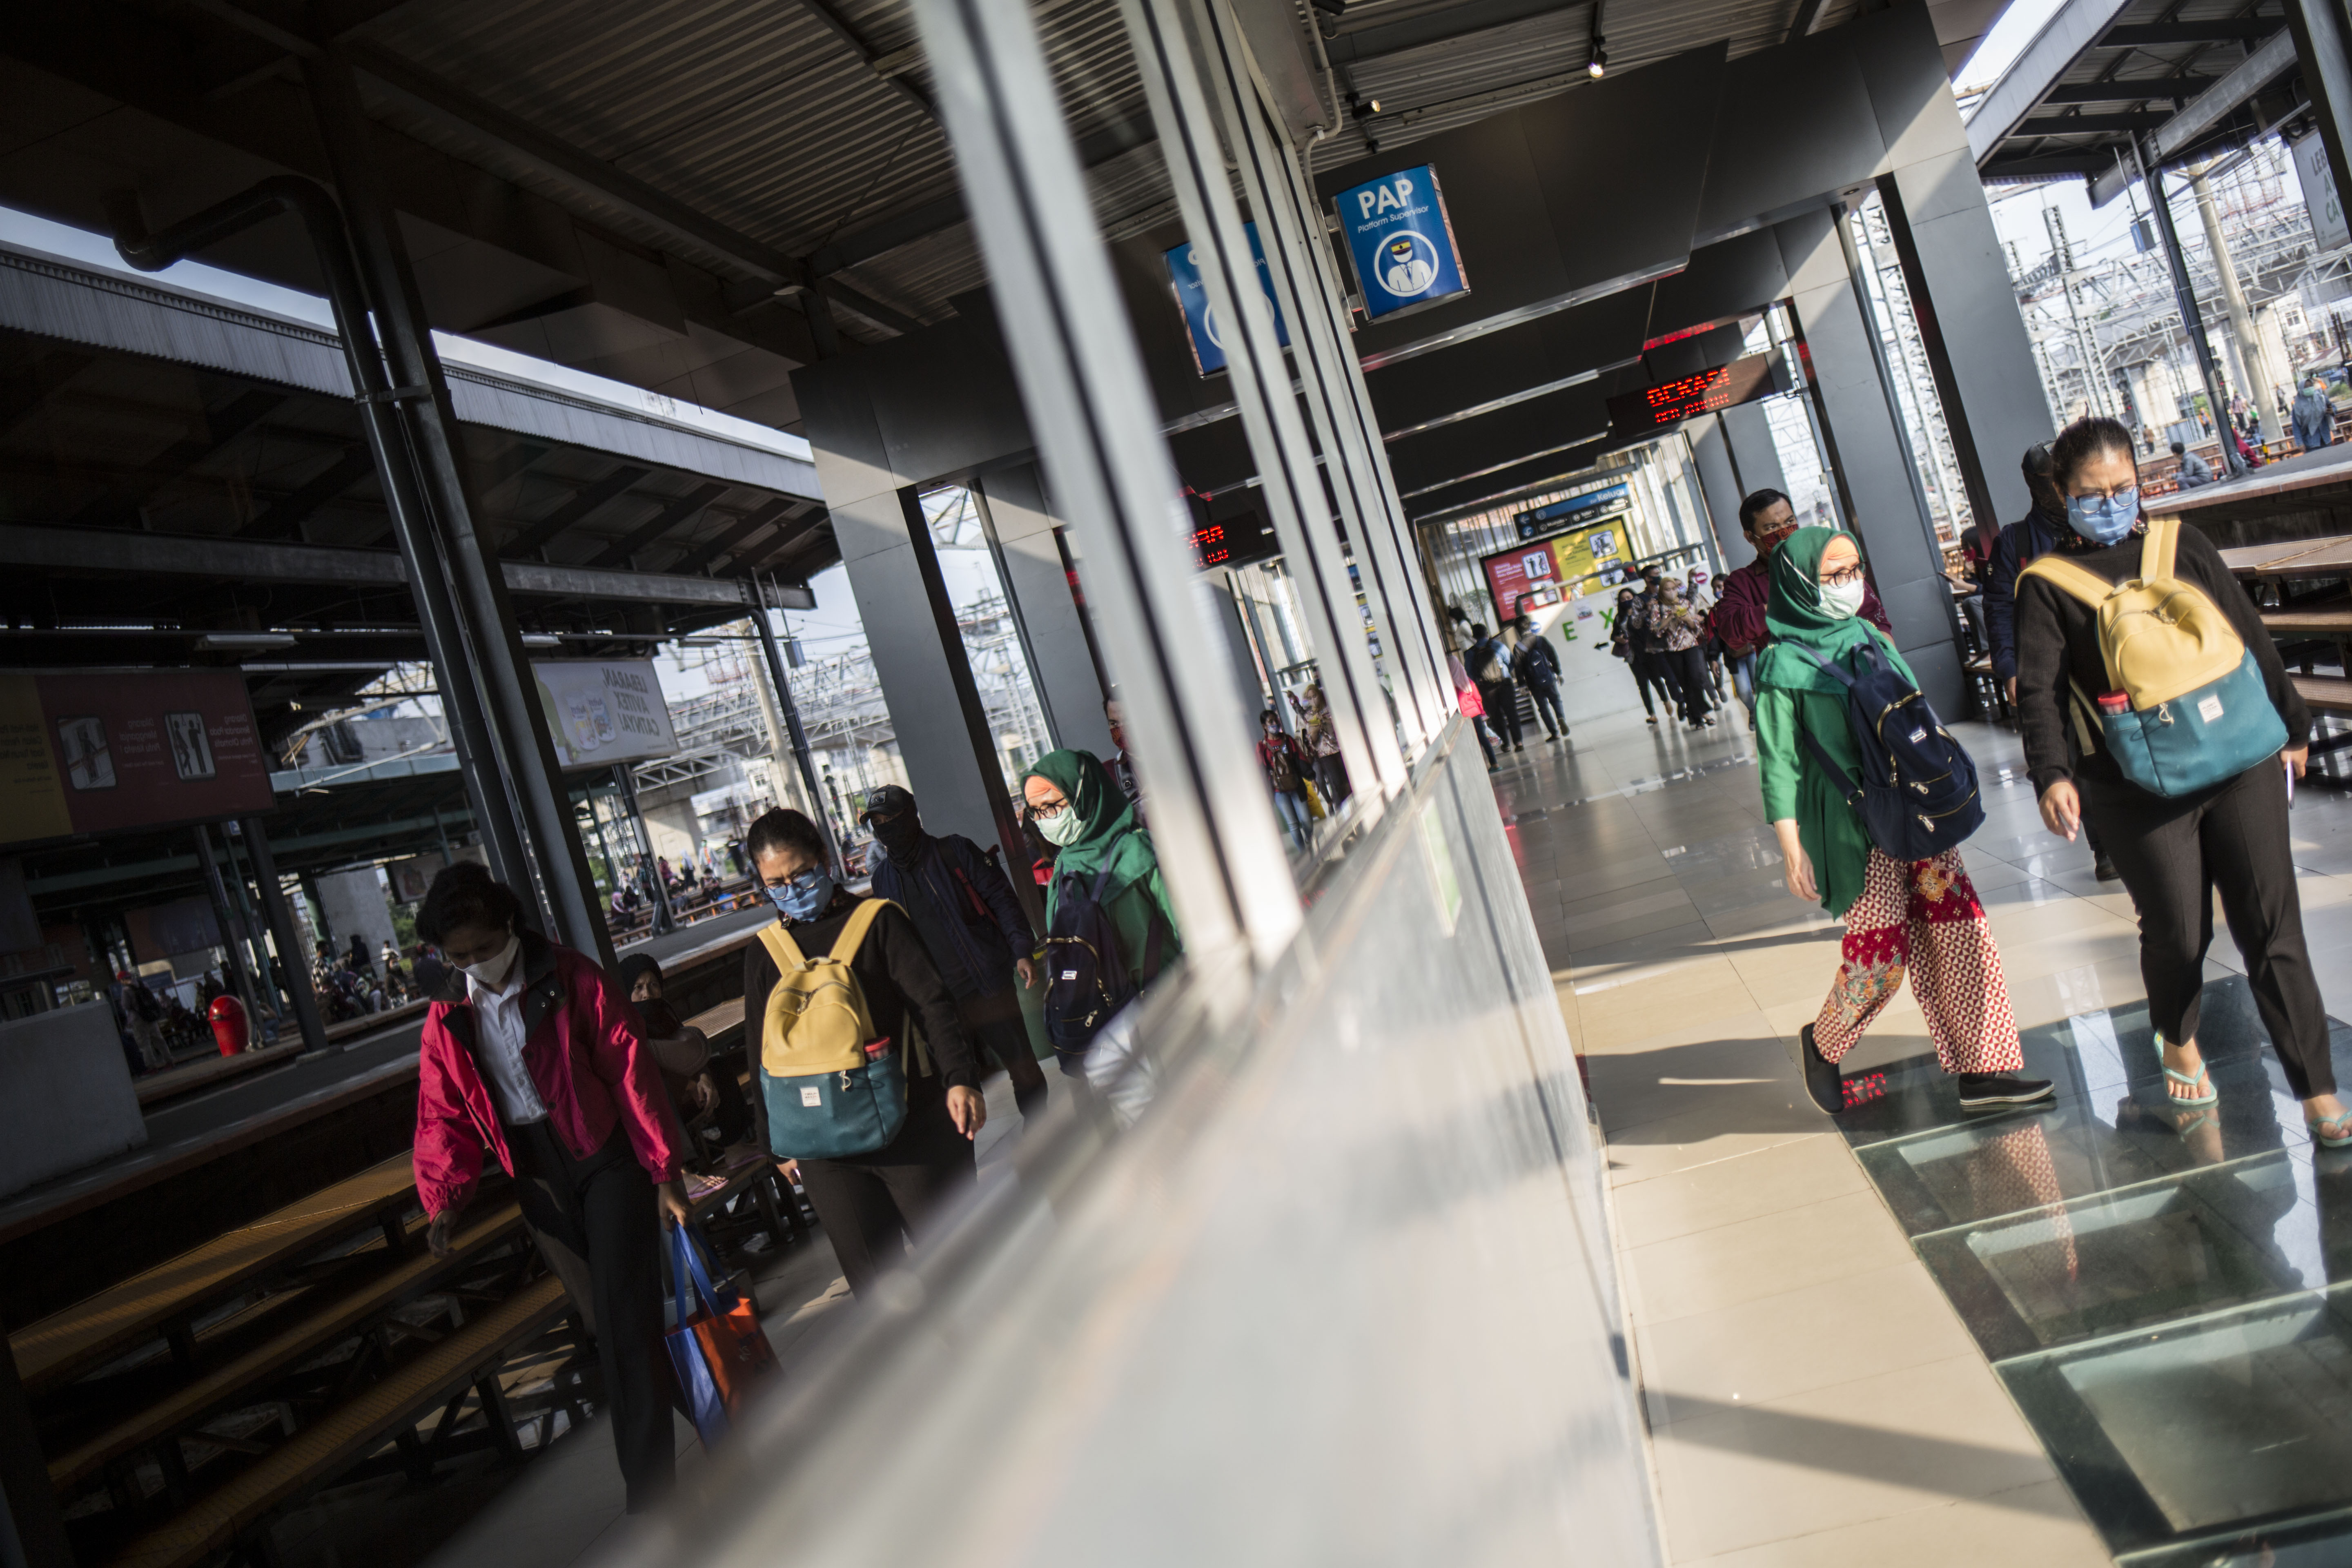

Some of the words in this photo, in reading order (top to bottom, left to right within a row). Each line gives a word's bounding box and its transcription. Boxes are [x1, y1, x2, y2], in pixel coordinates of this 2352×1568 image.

[1358, 179, 1413, 219] PAP
[1358, 217, 1388, 233] Platform
[1390, 205, 1429, 222] Supervisor
[1597, 488, 1624, 501] Keluar
